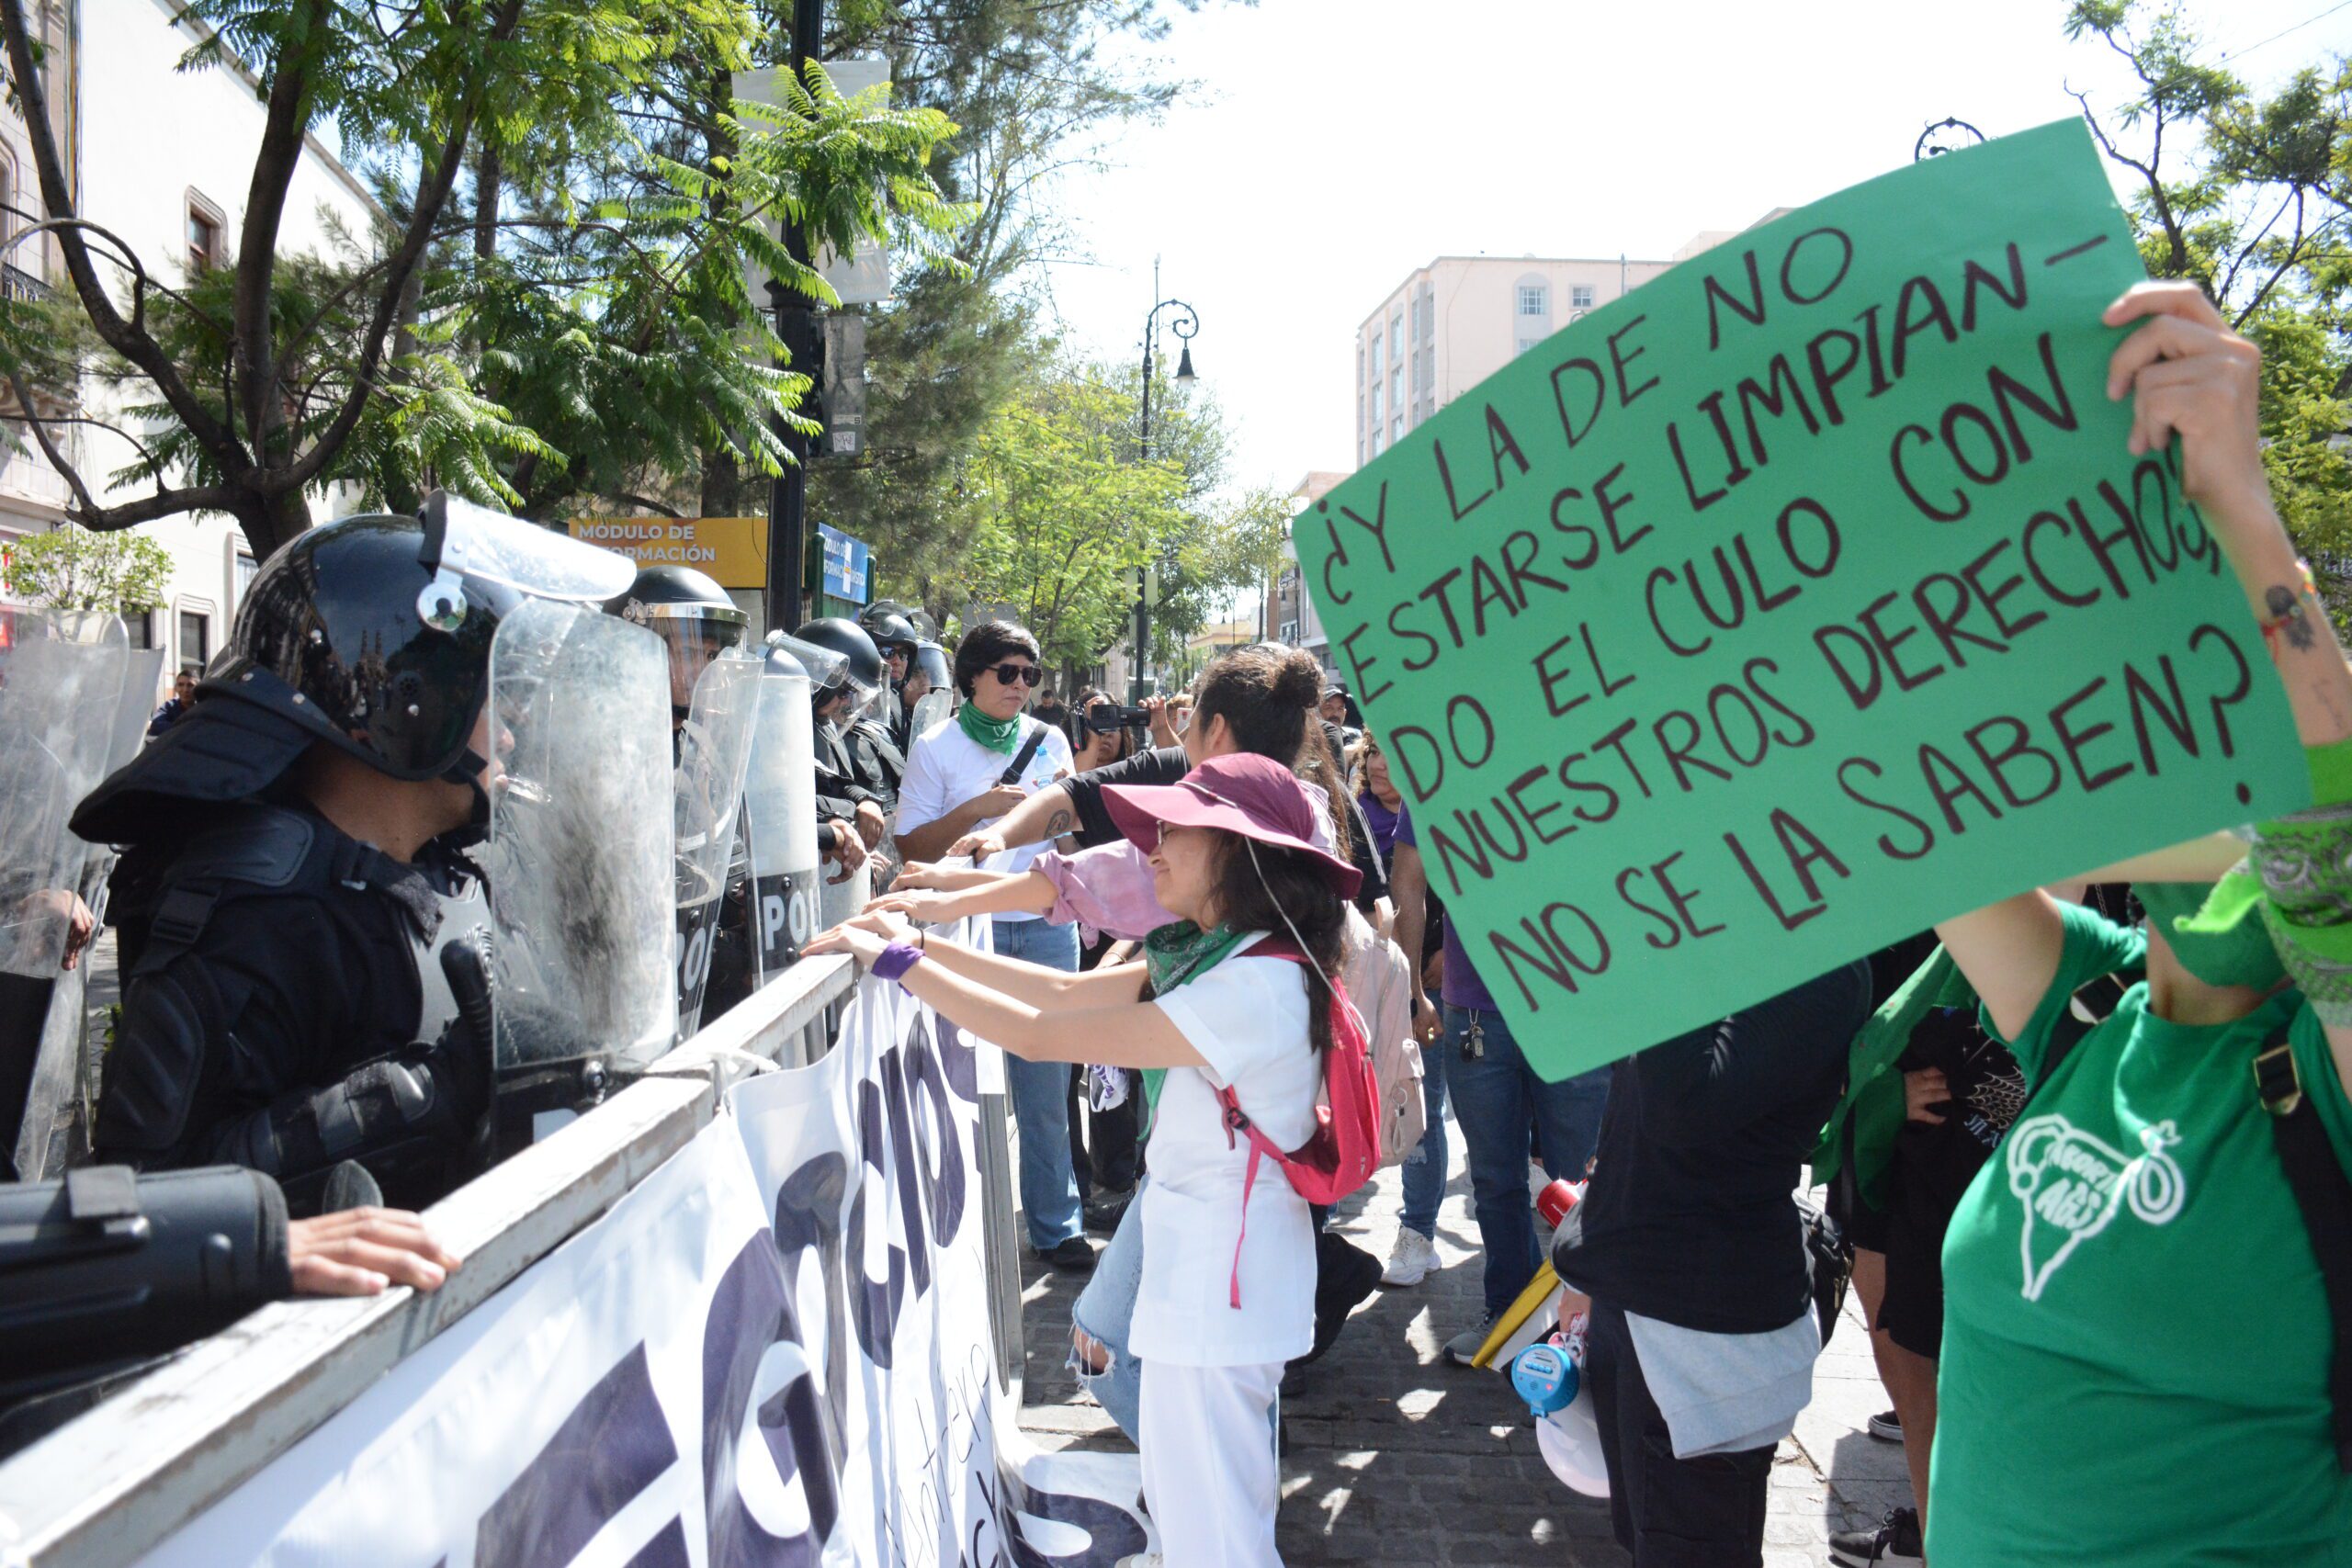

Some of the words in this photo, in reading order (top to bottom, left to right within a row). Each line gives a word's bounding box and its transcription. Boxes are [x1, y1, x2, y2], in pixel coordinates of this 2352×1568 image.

[669, 525, 695, 540] DE
[1316, 479, 1396, 604] ¿Y
[1433, 402, 1532, 520] LA
[1550, 314, 1662, 447] DE
[1702, 226, 1854, 351] NO
[1390, 694, 1496, 804] DO
[1532, 623, 1636, 717] EL
[1645, 496, 1842, 658] CULO
[1891, 332, 2079, 523] CON
[1342, 462, 1655, 705] ESTARSE
[1427, 657, 1815, 897] NUESTROS
[1488, 902, 1611, 1012] NO
[1616, 851, 1725, 949] SE
[1724, 808, 1850, 931] LA
[1837, 625, 2251, 860] SABEN?
